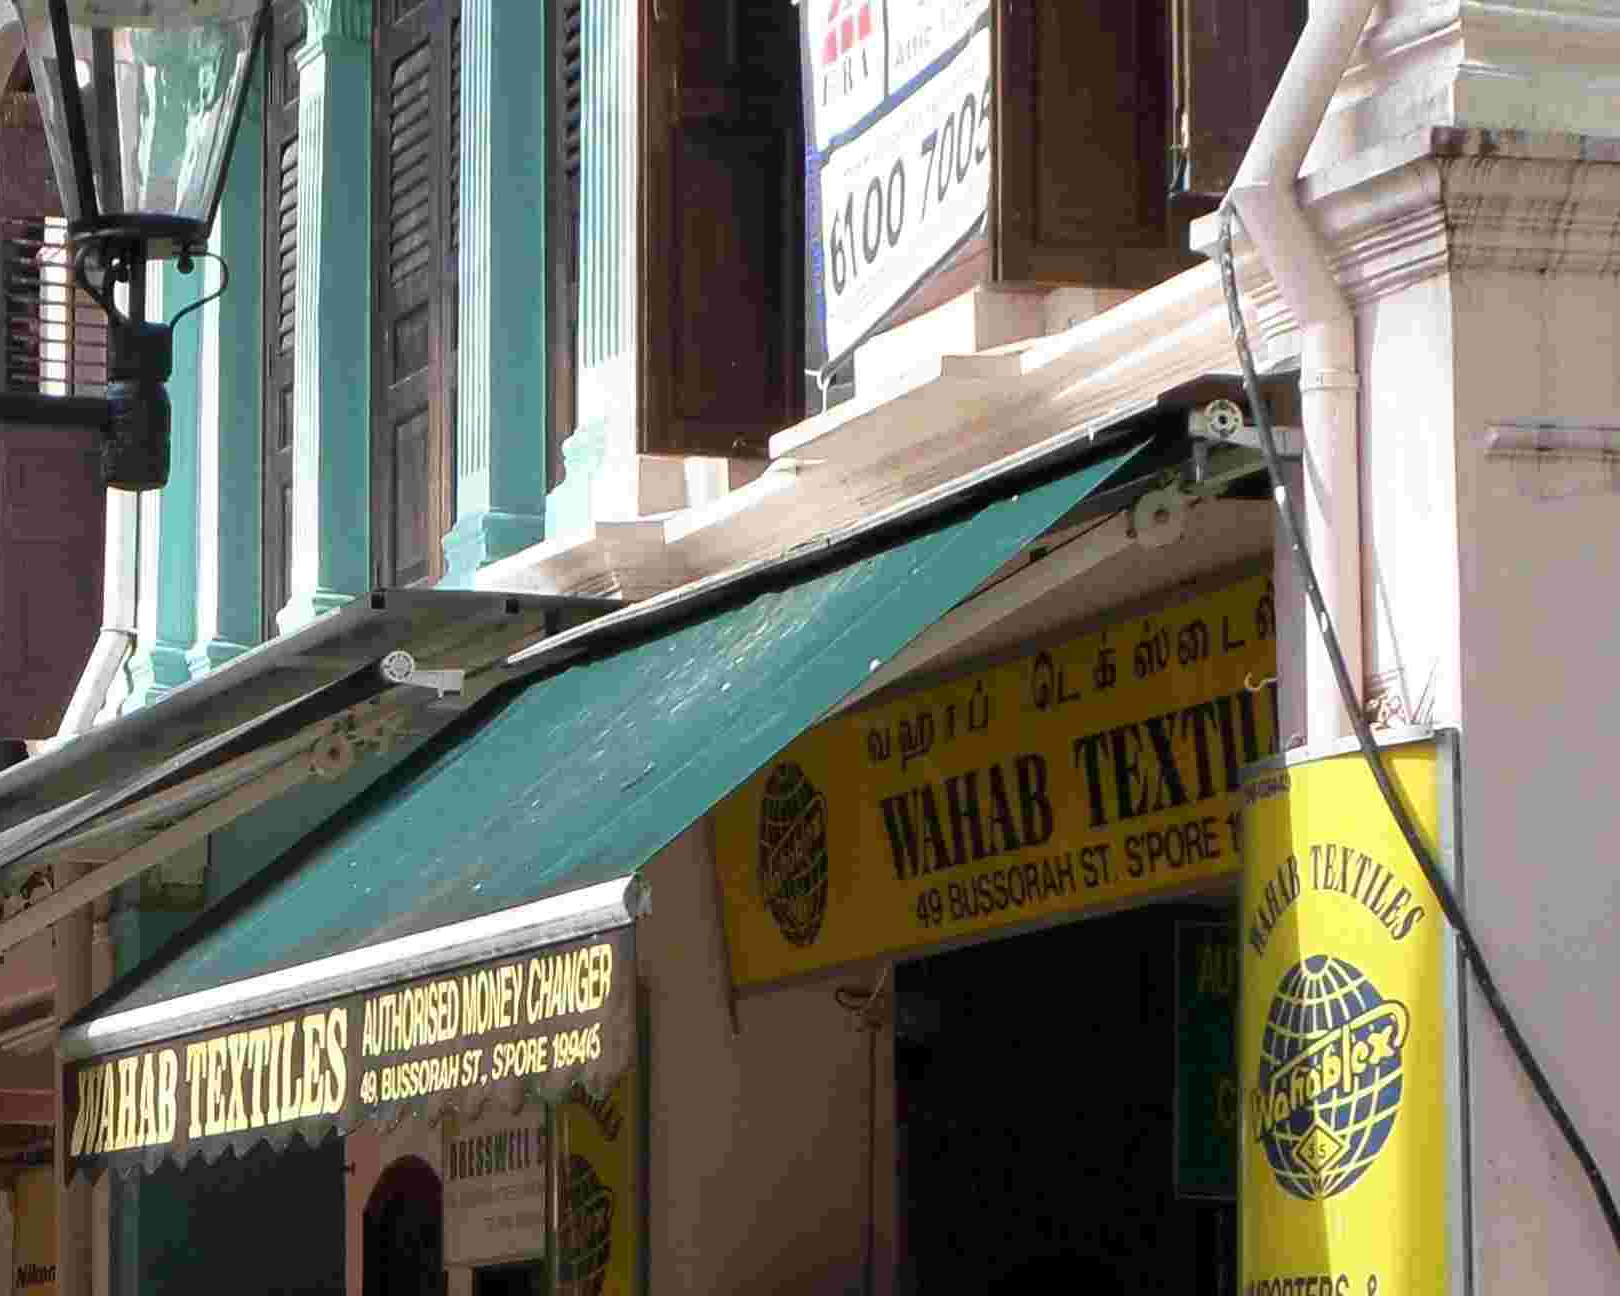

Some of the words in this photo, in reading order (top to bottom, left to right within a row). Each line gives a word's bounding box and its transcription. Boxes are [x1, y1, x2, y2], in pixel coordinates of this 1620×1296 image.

[830, 156, 907, 296] 6100
[879, 752, 1054, 882] WAHAB
[915, 886, 944, 928] 49
[948, 862, 1077, 921] BUSSORAH
[1310, 843, 1426, 941] TEXTILES
[362, 978, 460, 1057] AUTHORISED
[461, 963, 524, 1036] MONEY
[527, 943, 613, 1025] CHANGER
[70, 1048, 178, 1157] WAHAB
[184, 1007, 349, 1140] TEXTILES
[380, 1053, 460, 1101] BUSSORAH
